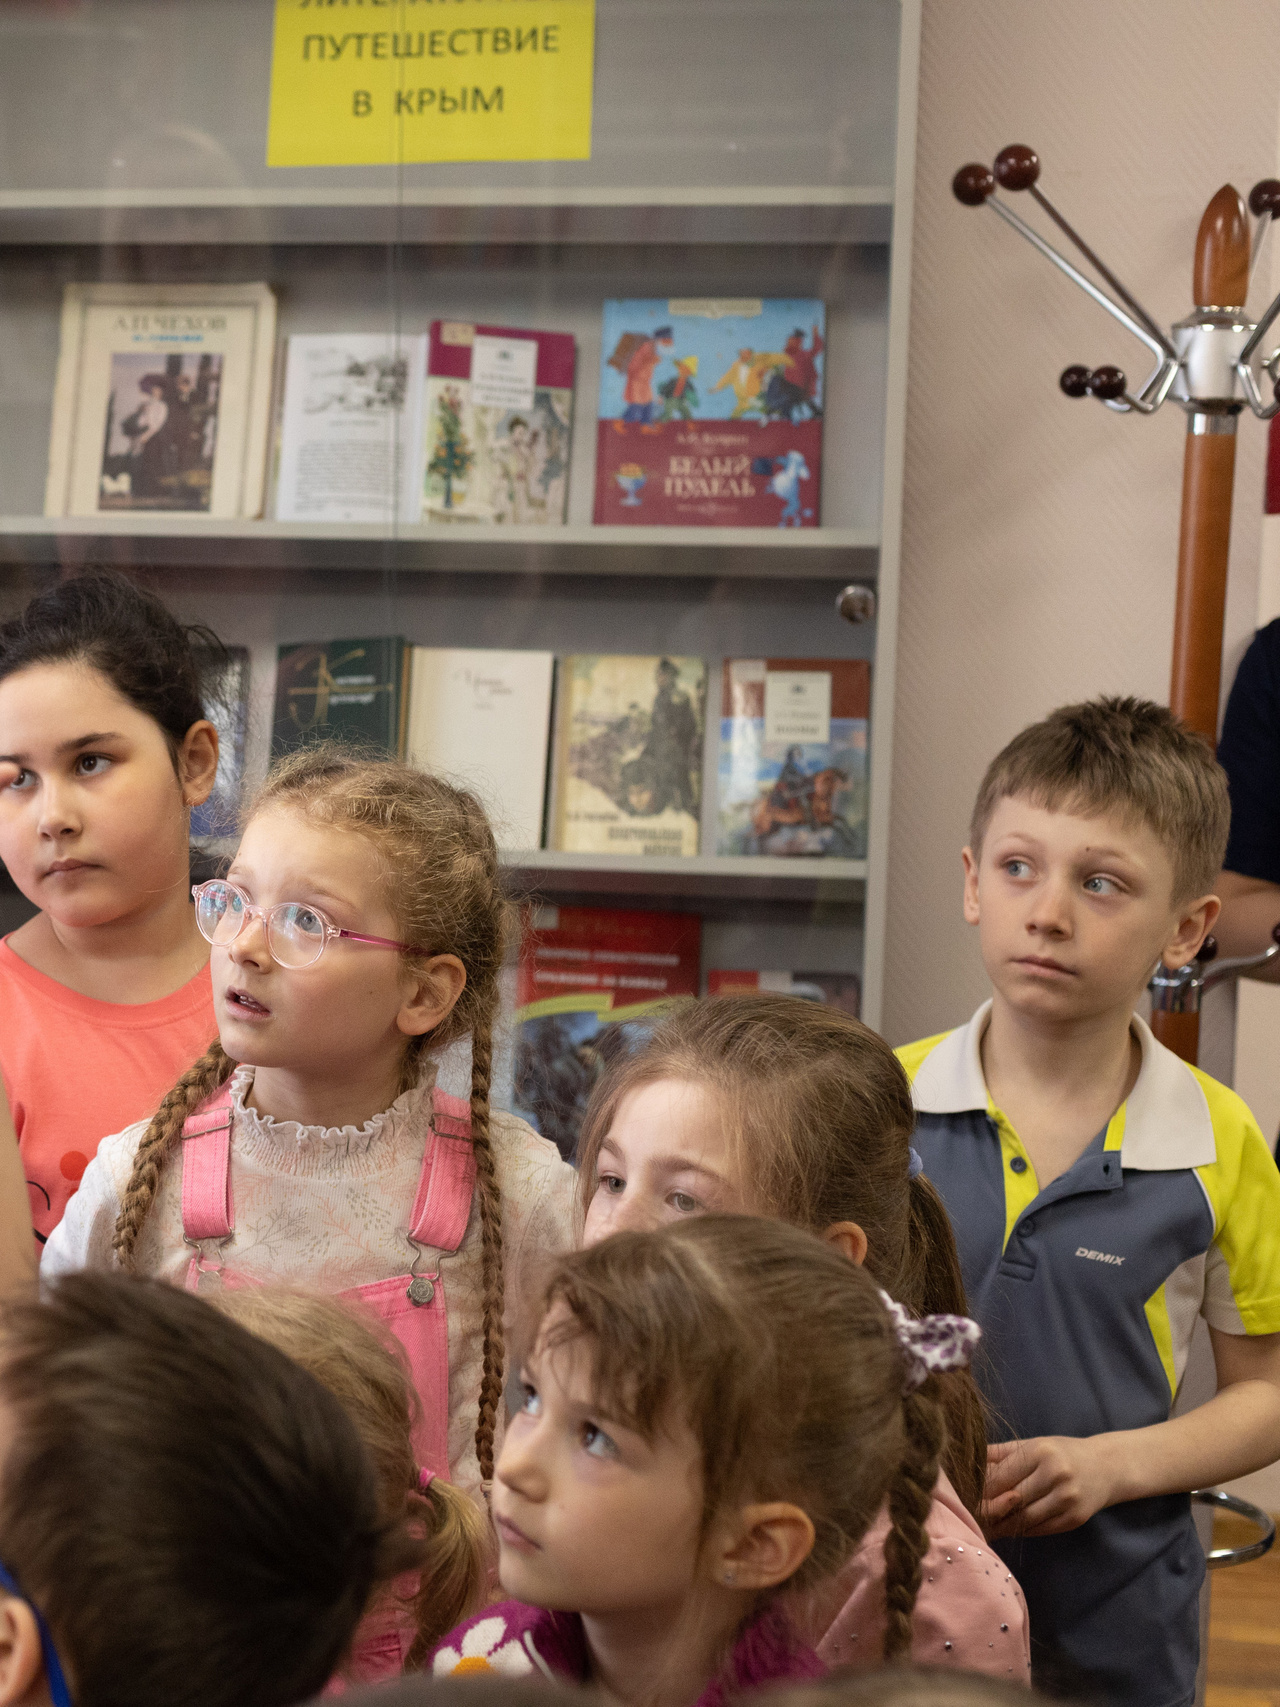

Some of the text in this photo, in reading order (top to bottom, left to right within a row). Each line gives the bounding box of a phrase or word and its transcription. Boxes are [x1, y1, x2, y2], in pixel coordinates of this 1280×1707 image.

[302, 24, 560, 61] ПУТЕШЕСТВИЕ
[352, 86, 505, 118] В КРЫМ
[1075, 1246, 1126, 1266] DEMIX
